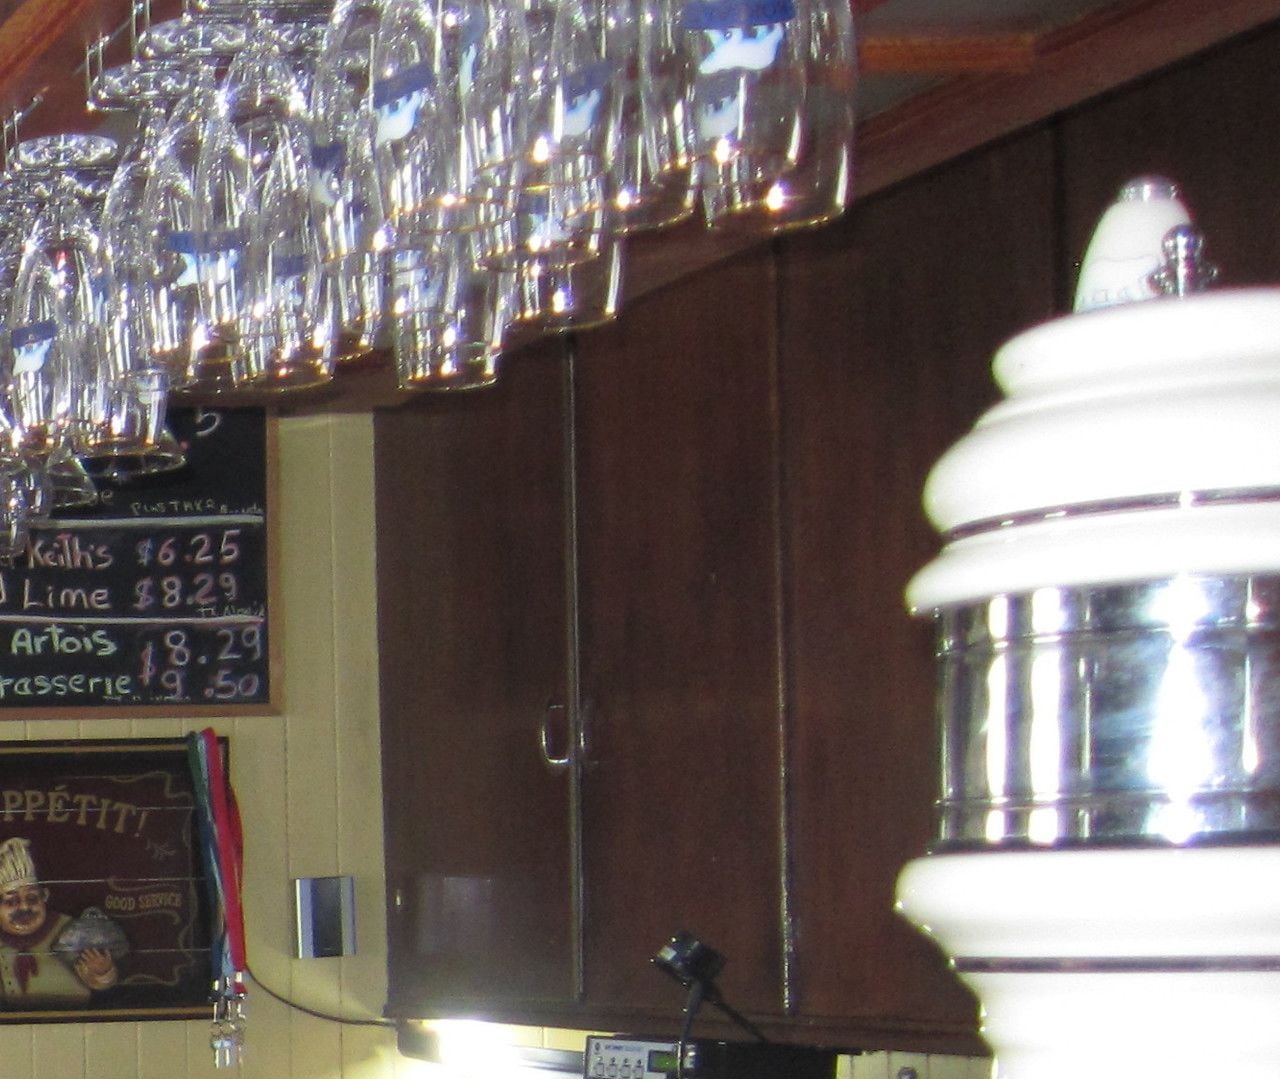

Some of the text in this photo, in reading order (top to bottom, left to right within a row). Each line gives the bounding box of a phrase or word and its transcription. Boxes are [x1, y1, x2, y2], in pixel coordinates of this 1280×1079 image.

[137, 529, 241, 568] $6.25
[23, 578, 112, 610] Lime
[134, 572, 238, 610] $8.29
[10, 623, 117, 657] Artois
[105, 893, 136, 911] GOOD
